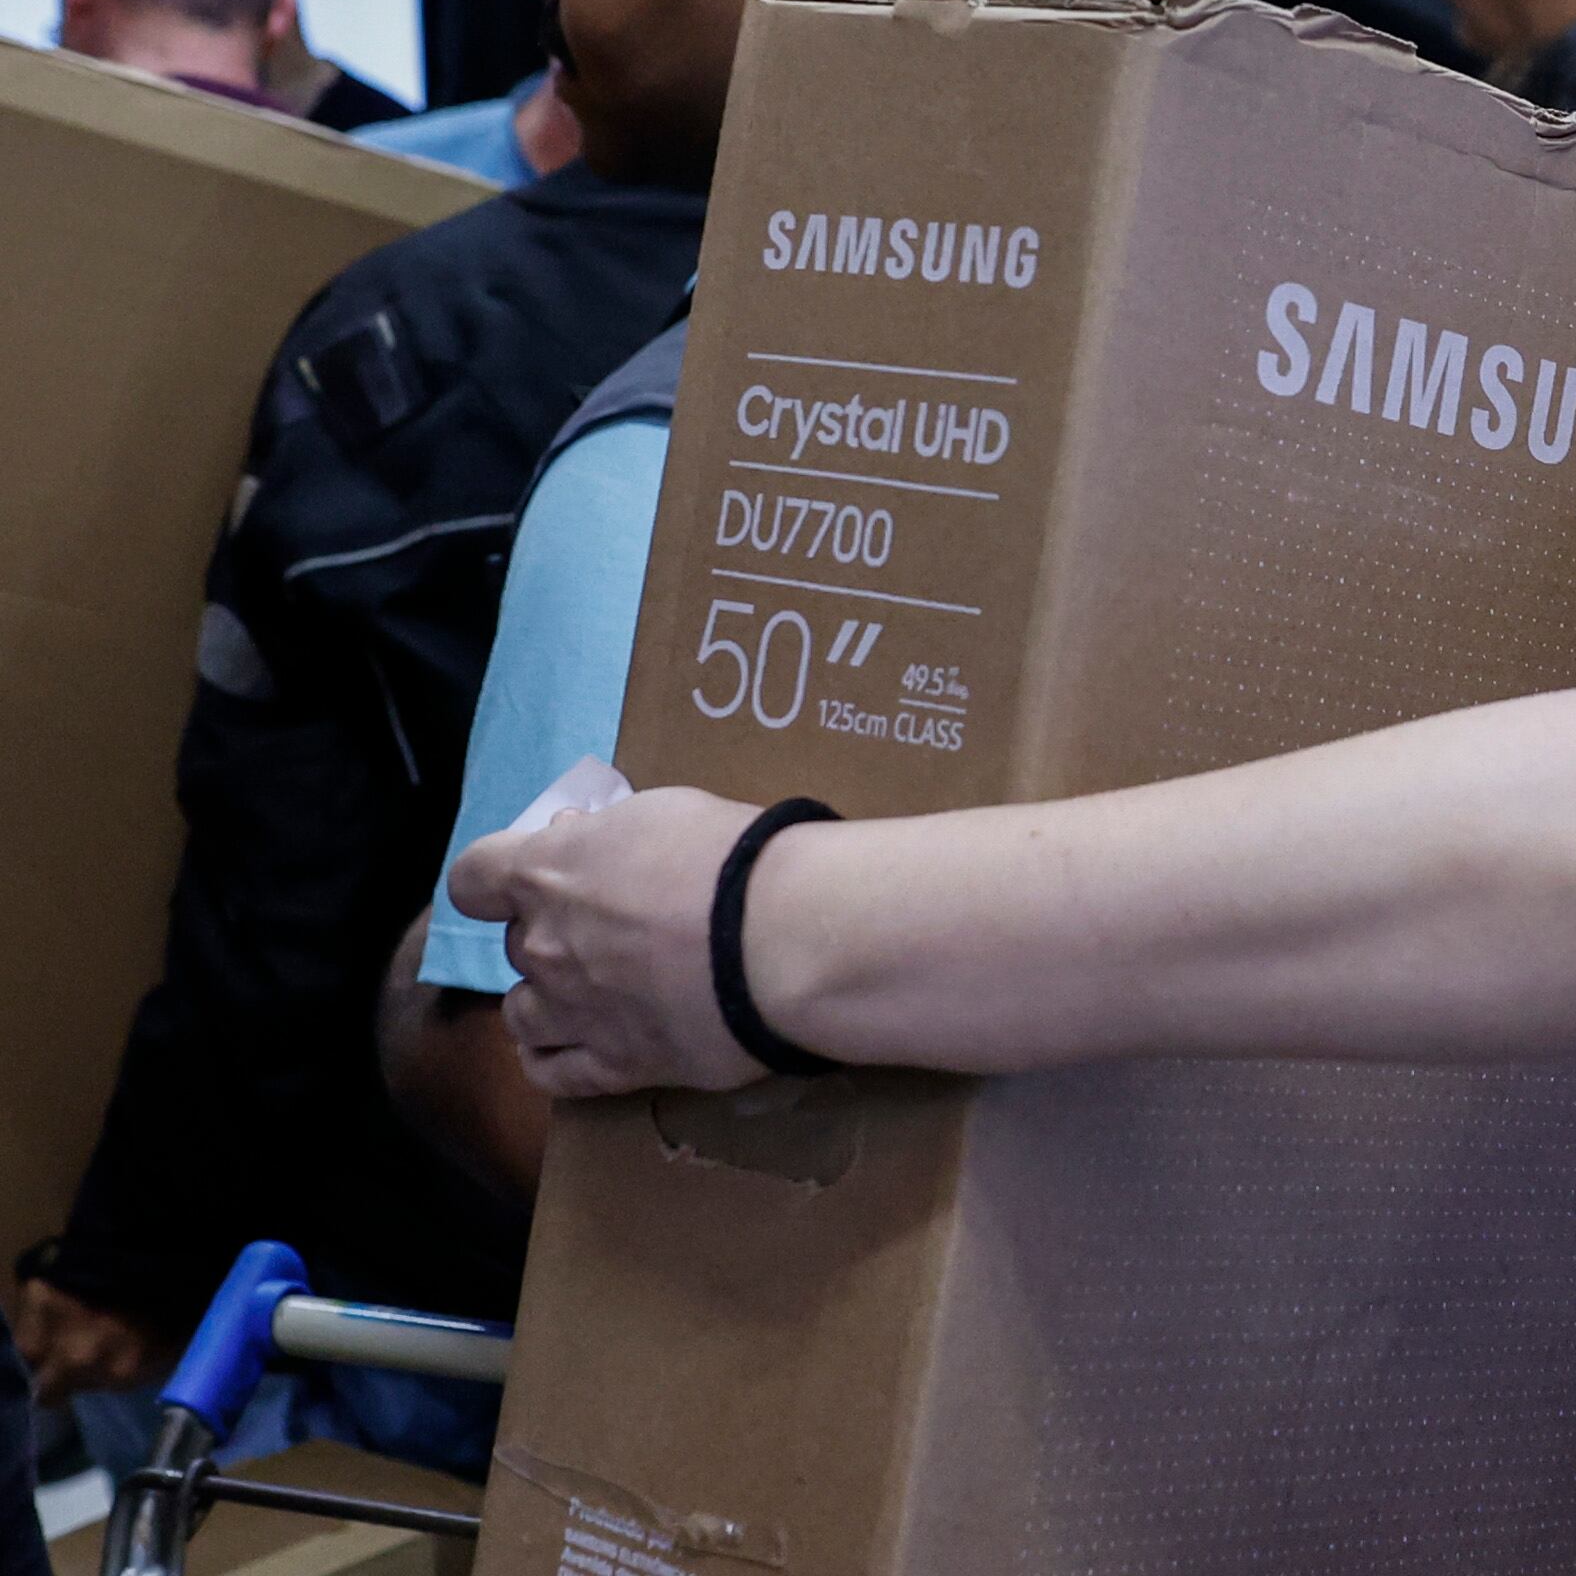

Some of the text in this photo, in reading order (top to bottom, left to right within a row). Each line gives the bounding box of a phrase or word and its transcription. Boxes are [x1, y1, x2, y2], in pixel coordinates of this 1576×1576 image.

[763, 209, 1040, 289] SAMSUNG
[736, 384, 1011, 465] Crystal UHD
[715, 489, 894, 568] DU7700
[818, 698, 966, 751] 125cm CLASS
